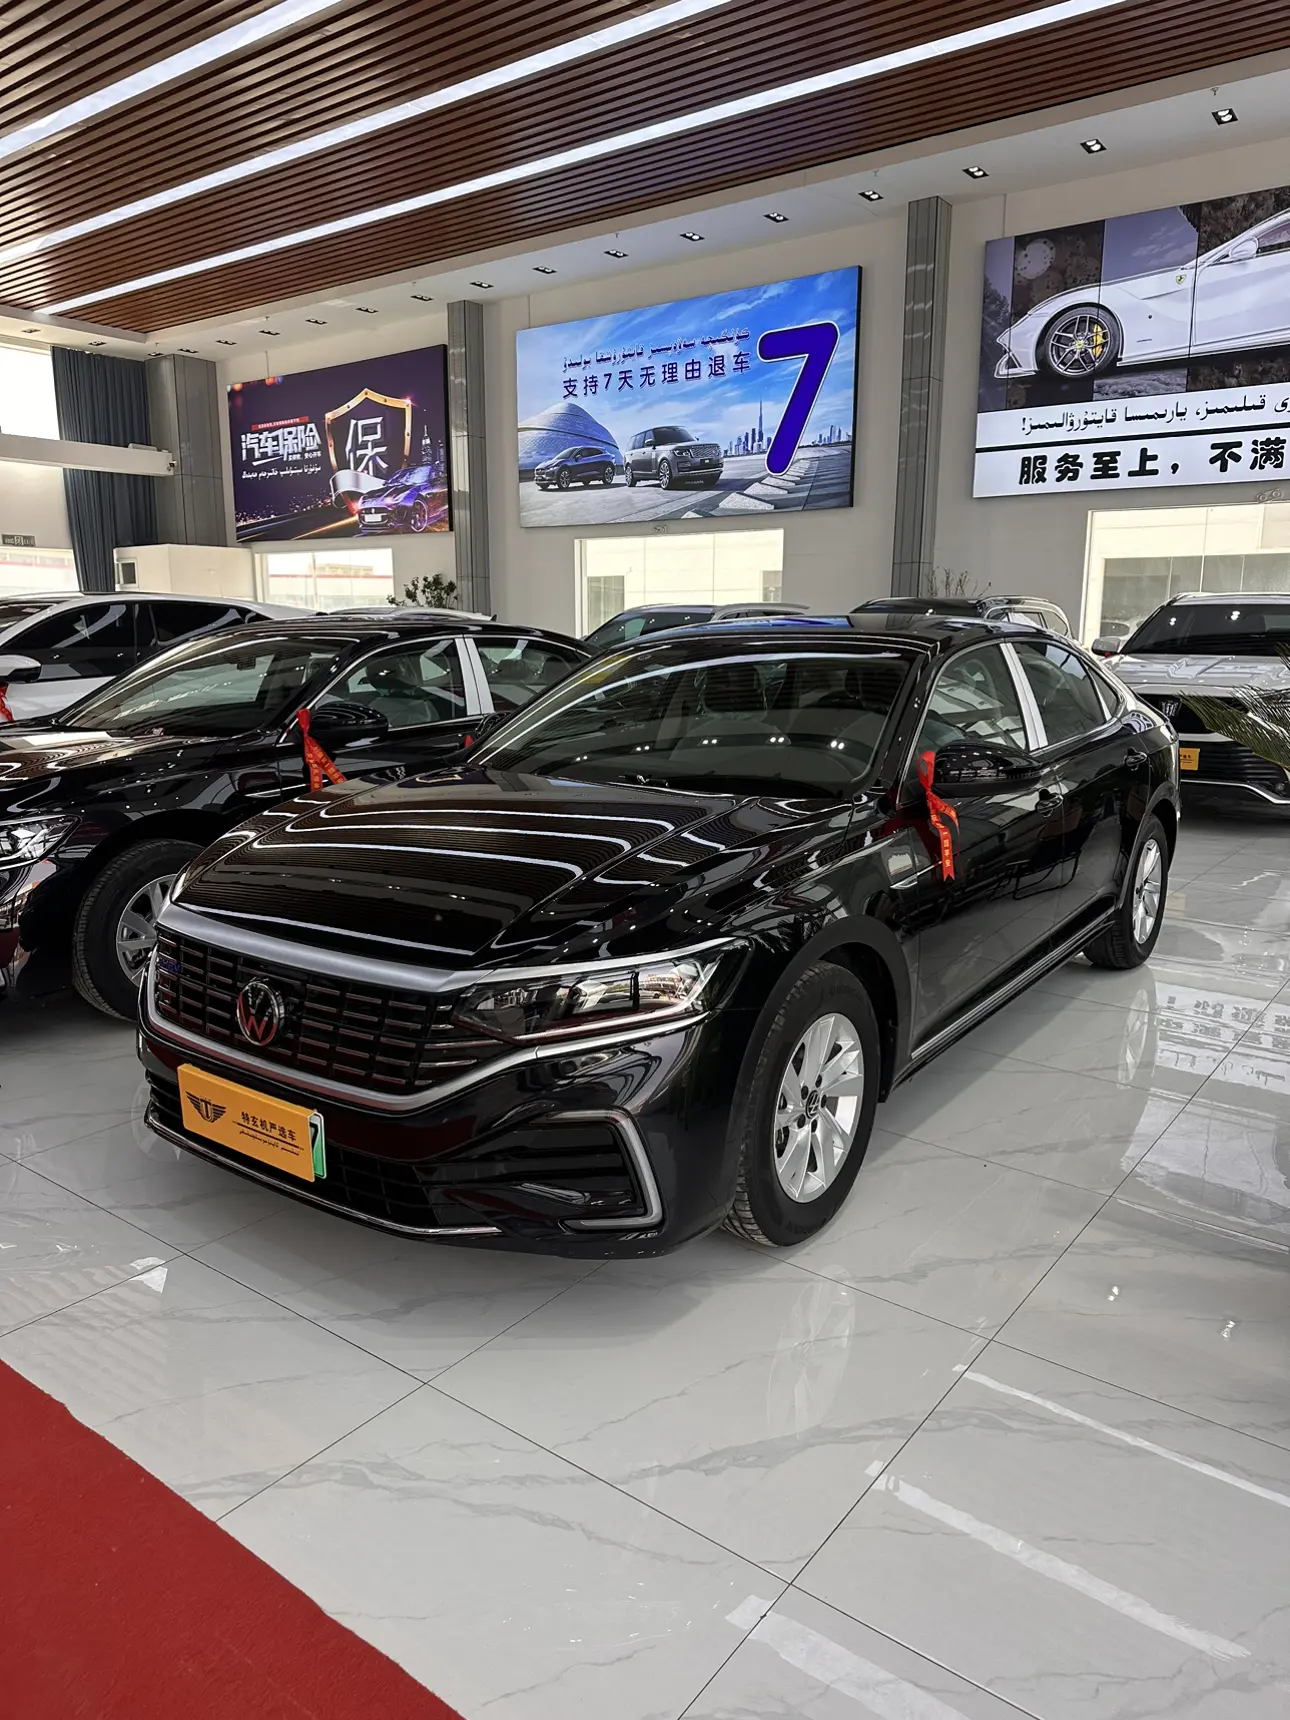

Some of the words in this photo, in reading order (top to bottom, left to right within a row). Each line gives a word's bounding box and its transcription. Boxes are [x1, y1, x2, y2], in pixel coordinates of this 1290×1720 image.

[563, 351, 751, 399] 支持7天无理由退车
[757, 321, 839, 476] 7
[241, 423, 322, 462] 汽车保险
[345, 416, 388, 476] 保
